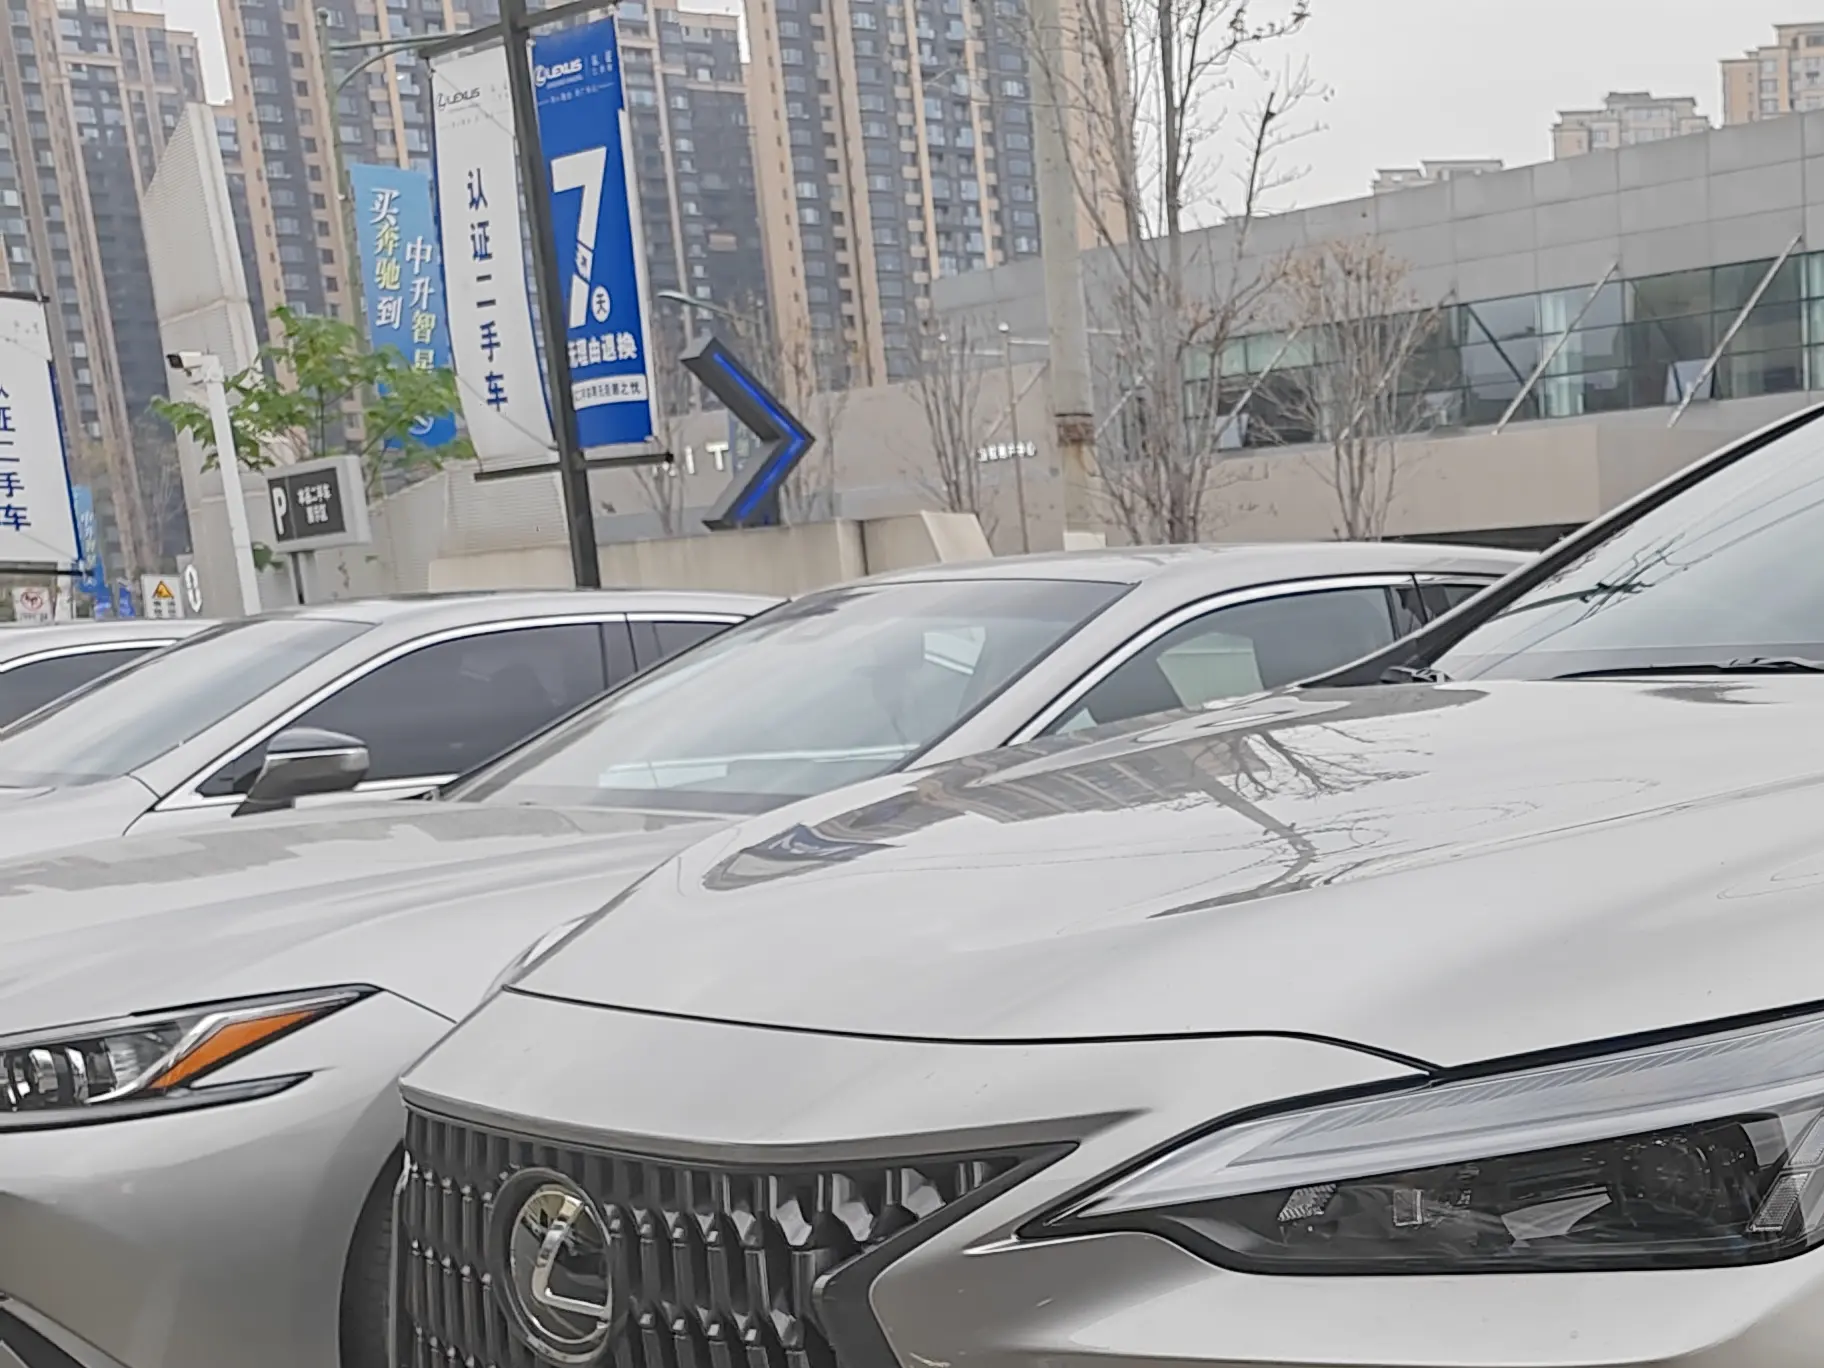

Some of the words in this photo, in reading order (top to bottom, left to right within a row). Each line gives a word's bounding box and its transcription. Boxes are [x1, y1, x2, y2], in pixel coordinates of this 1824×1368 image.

[547, 57, 582, 79] LEXUS
[448, 87, 480, 103] LEXUS
[369, 188, 402, 330] 买奔驰到
[467, 168, 508, 412] 认证二手车
[272, 487, 287, 535] P
